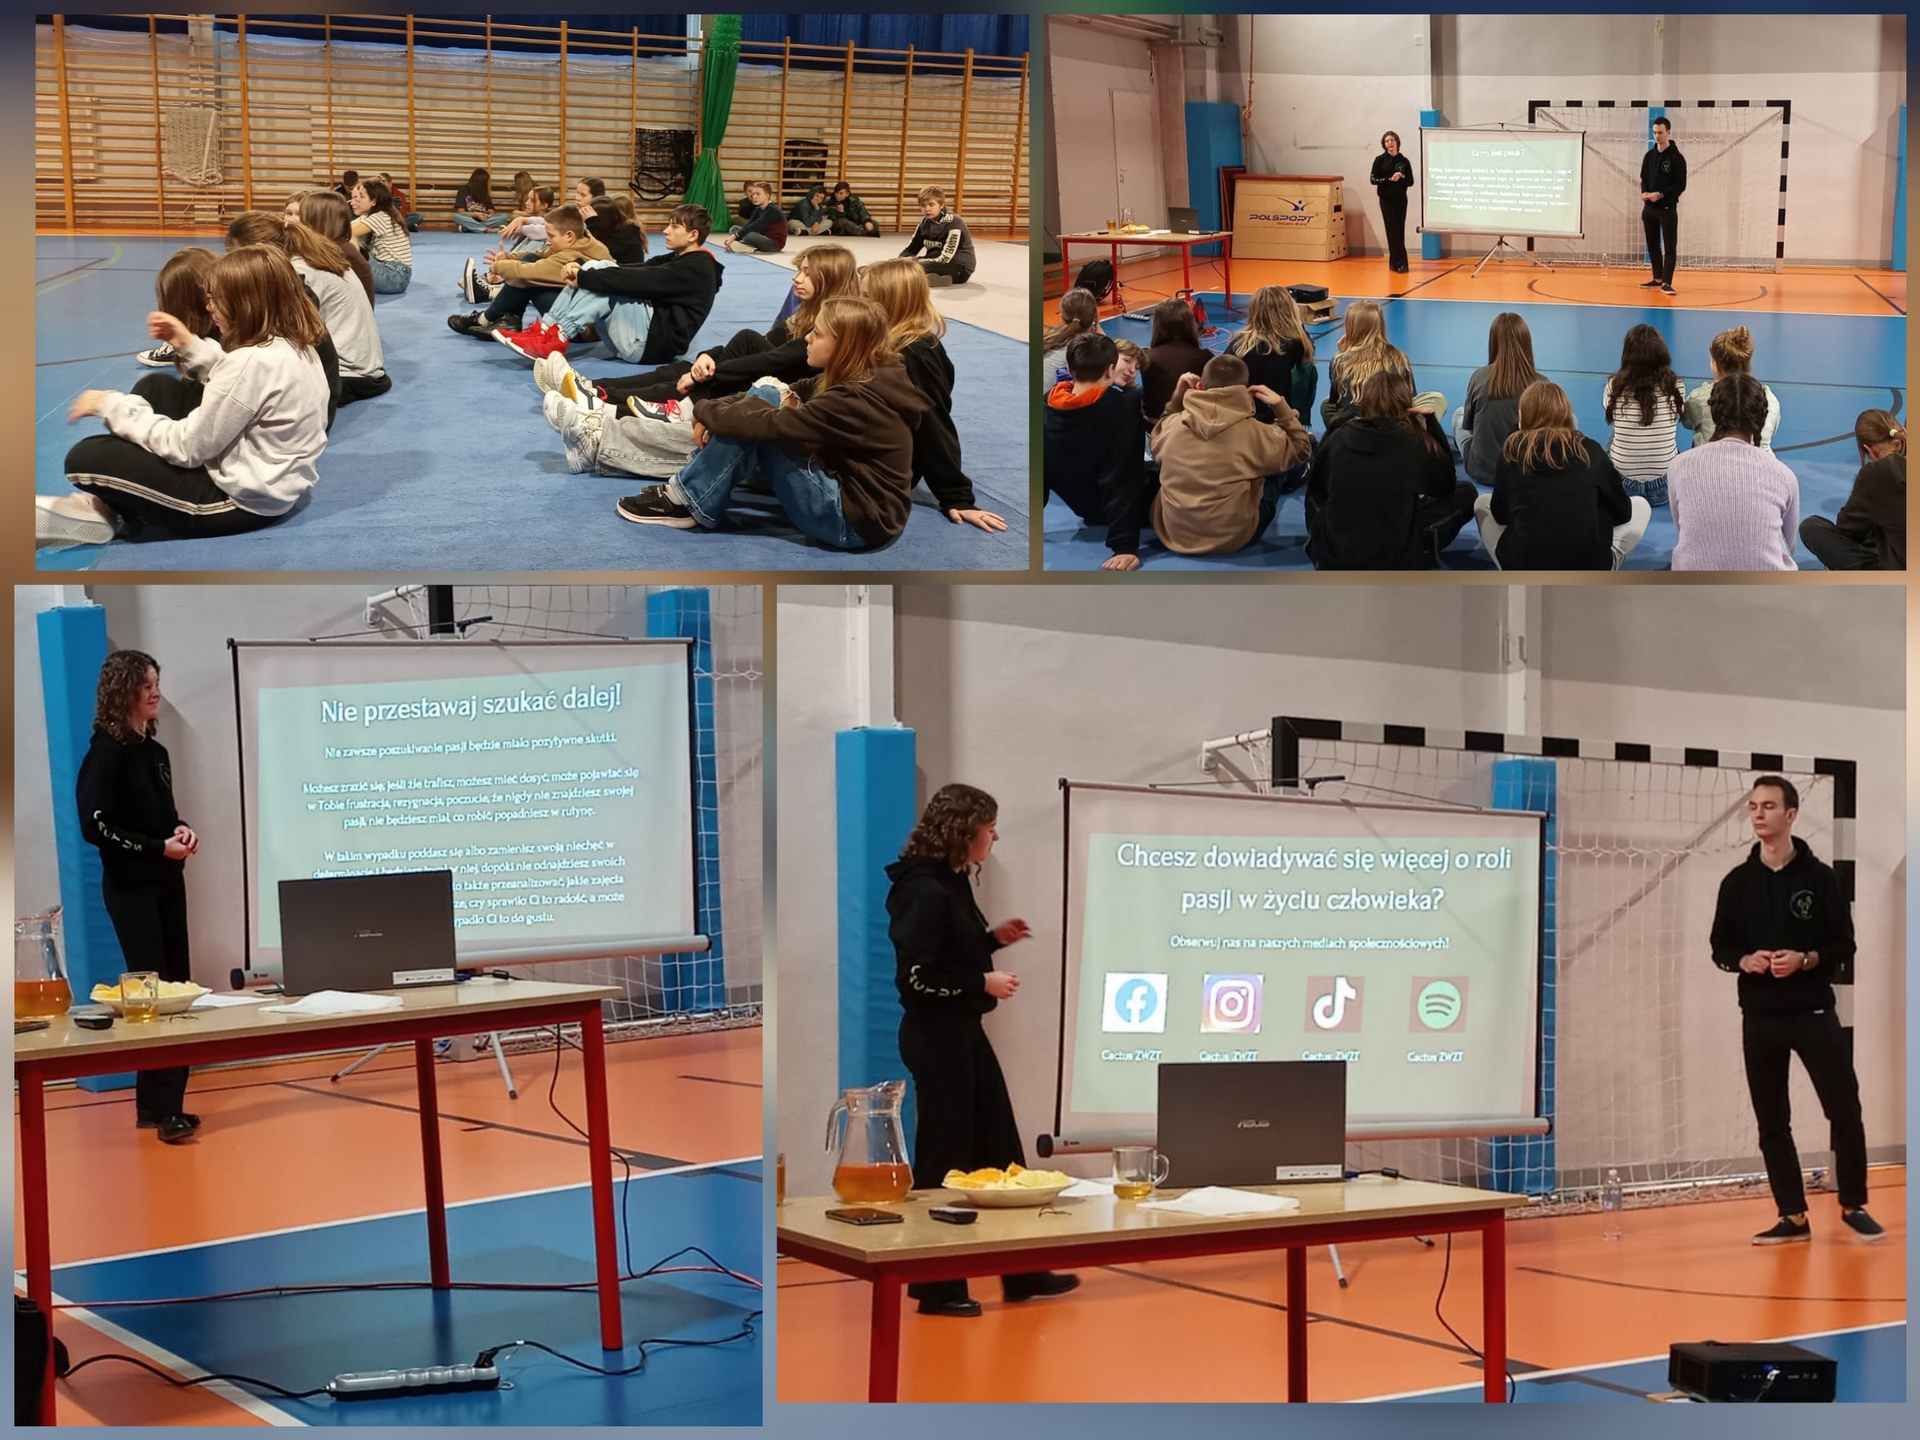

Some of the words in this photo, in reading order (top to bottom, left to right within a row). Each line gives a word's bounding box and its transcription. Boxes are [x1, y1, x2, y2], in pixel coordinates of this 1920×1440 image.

[1249, 214, 1315, 223] POLSPORT
[321, 699, 357, 723] Nie
[363, 695, 477, 727] przestawaj
[482, 689, 557, 715] szukać
[562, 682, 622, 713] dalej!
[324, 747, 341, 758] Nie
[343, 747, 377, 758] zawsze
[378, 743, 443, 759] poszukiwanie
[445, 741, 467, 755] pasji
[469, 738, 500, 752] będzie
[531, 734, 584, 750] pozytywne
[585, 732, 617, 744] skutki.
[303, 782, 339, 794] Możesz
[456, 775, 493, 788] możesz
[494, 774, 518, 785] mieć
[551, 771, 578, 782] może
[579, 768, 623, 782] pojawiać
[624, 767, 639, 779] się
[318, 799, 345, 811] Tobie
[505, 790, 531, 804] nigdy
[534, 790, 549, 800] nie
[551, 788, 601, 801] znajdziesz
[603, 785, 634, 800] swojej
[369, 815, 384, 826] nie
[386, 813, 427, 827] będziesz
[494, 808, 550, 822] popadniesz
[324, 851, 335, 862] W
[364, 848, 406, 862] wypadku
[408, 848, 447, 862] poddasz
[449, 846, 463, 858] się
[464, 845, 486, 856] albo
[487, 844, 535, 855] zamienisz
[1117, 842, 1197, 868] Chcesz
[1203, 845, 1338, 874] dowiadywać
[1343, 848, 1375, 873] się
[1381, 848, 1449, 875] więcej
[1455, 852, 1469, 869] o
[1475, 846, 1512, 869] roli
[533, 858, 590, 872] odnajdziesz
[591, 856, 626, 867] swoich
[566, 876, 589, 888] jakie
[598, 892, 625, 902] może
[1181, 889, 1232, 915] pasji
[1238, 892, 1258, 909] w
[1263, 889, 1320, 915] życiu
[1326, 887, 1444, 911] człowieka?
[1170, 934, 1220, 950] Obserwuj
[1223, 938, 1241, 948] nas
[1243, 938, 1256, 948] na
[1259, 937, 1300, 951] naszych
[1302, 937, 1346, 949] mediach
